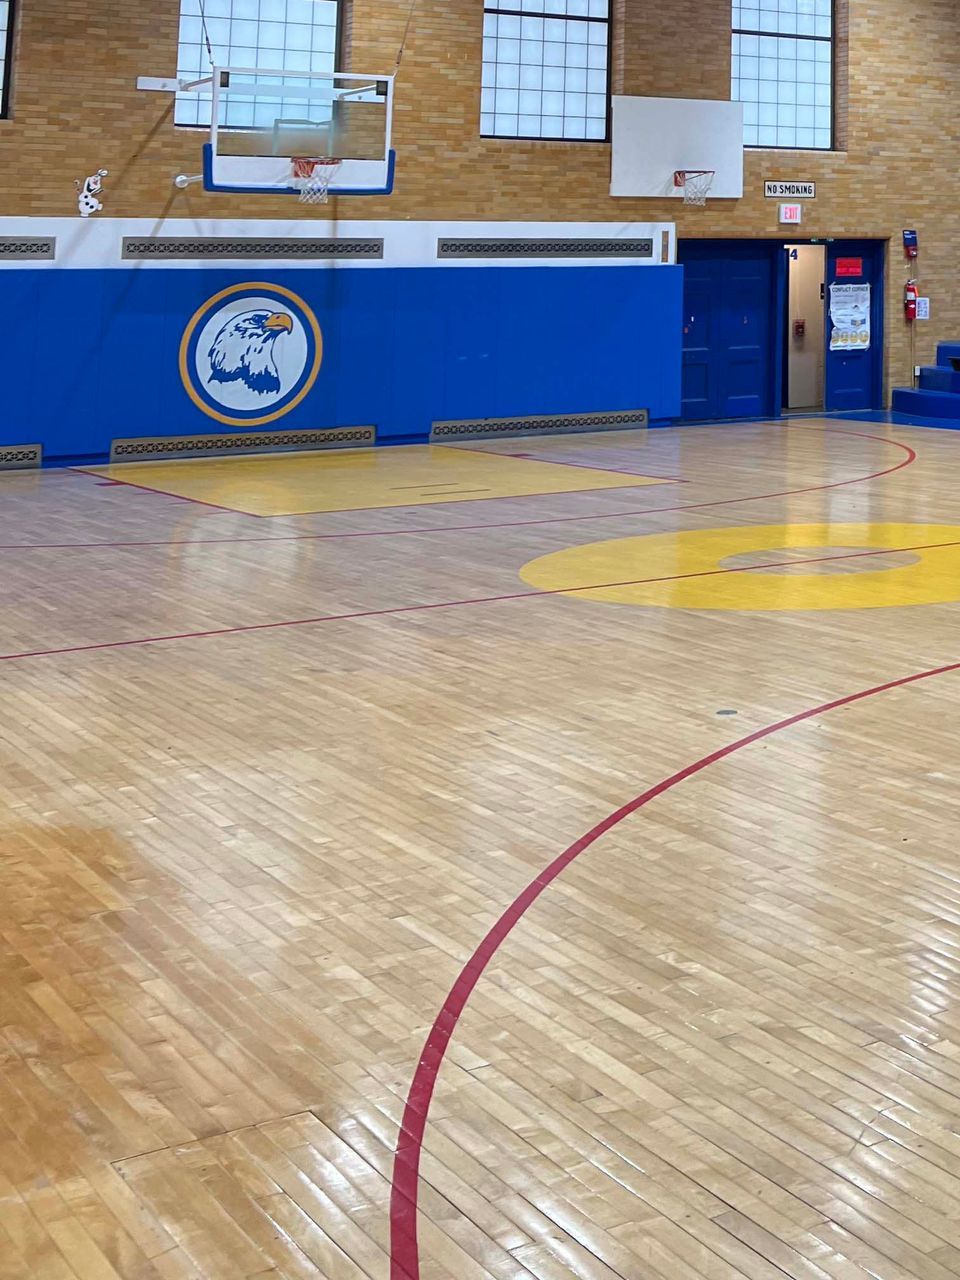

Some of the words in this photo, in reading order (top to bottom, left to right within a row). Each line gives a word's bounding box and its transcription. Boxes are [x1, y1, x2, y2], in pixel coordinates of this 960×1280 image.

[767, 184, 777, 194] NO
[780, 184, 813, 195] SMOKING
[784, 206, 798, 220] EXIT
